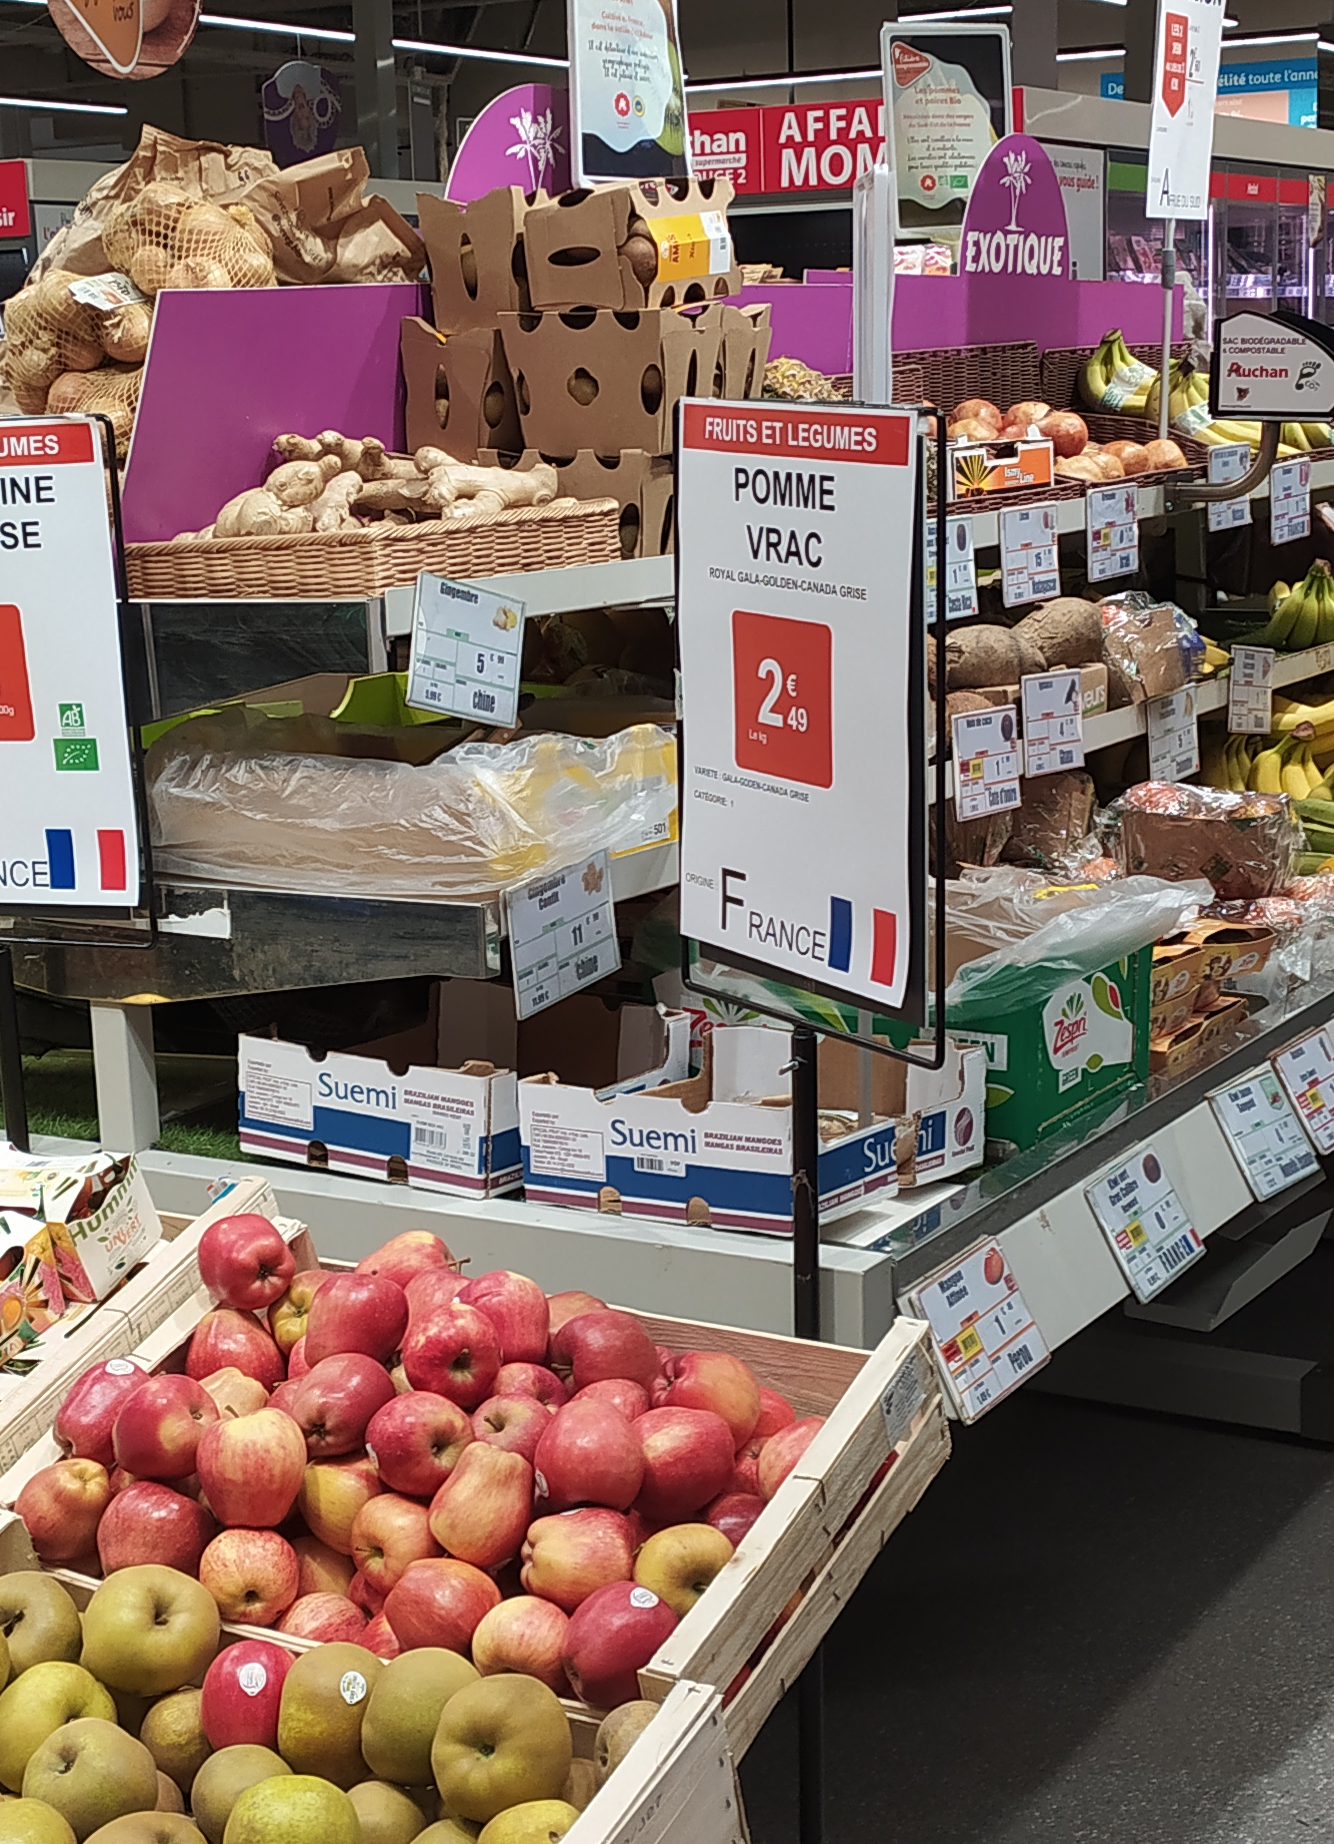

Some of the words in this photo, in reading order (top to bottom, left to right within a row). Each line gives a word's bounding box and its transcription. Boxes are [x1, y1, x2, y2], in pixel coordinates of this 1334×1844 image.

[1248, 72, 1280, 87] toute
[778, 105, 886, 144] AFFAI
[695, 156, 742, 166] supermarché
[780, 143, 887, 188] MOM
[966, 231, 1065, 276] EXOTIQUE
[1223, 337, 1239, 345] SAC
[1240, 336, 1307, 346] BIODÉGRADABLE
[1228, 347, 1286, 355] COMPOSTABLE
[1227, 362, 1289, 378] Auchan
[705, 417, 757, 443] FRUITS
[762, 420, 783, 445] ET
[788, 423, 877, 451] LEGUMES
[734, 467, 836, 511] POMME
[746, 525, 823, 568] VRAC
[440, 581, 479, 604] Gingembre
[709, 567, 736, 582] ROYAL
[737, 571, 838, 596] GALA-GOLDEN-CANADA
[839, 586, 867, 600] GRISE
[476, 653, 485, 674] 5
[757, 658, 784, 727] 2
[787, 706, 808, 733] 49
[748, 729, 758, 740] Le
[759, 731, 768, 745] kg
[685, 872, 714, 890] ORIGINE
[720, 867, 827, 963] FRANCE
[317, 1073, 396, 1110] Suemi
[404, 1089, 439, 1103] BRAZILIAN
[441, 1094, 474, 1108] MANGOES
[403, 1098, 431, 1111] MANGAS
[433, 1103, 474, 1116] BRASILEIRAS
[610, 1119, 696, 1154] Suemi
[704, 1131, 742, 1142] BRAZILIAN
[745, 1136, 782, 1146] MANGOES
[704, 1141, 734, 1151] MANGAS
[735, 1144, 782, 1155] BRASILEIRAS
